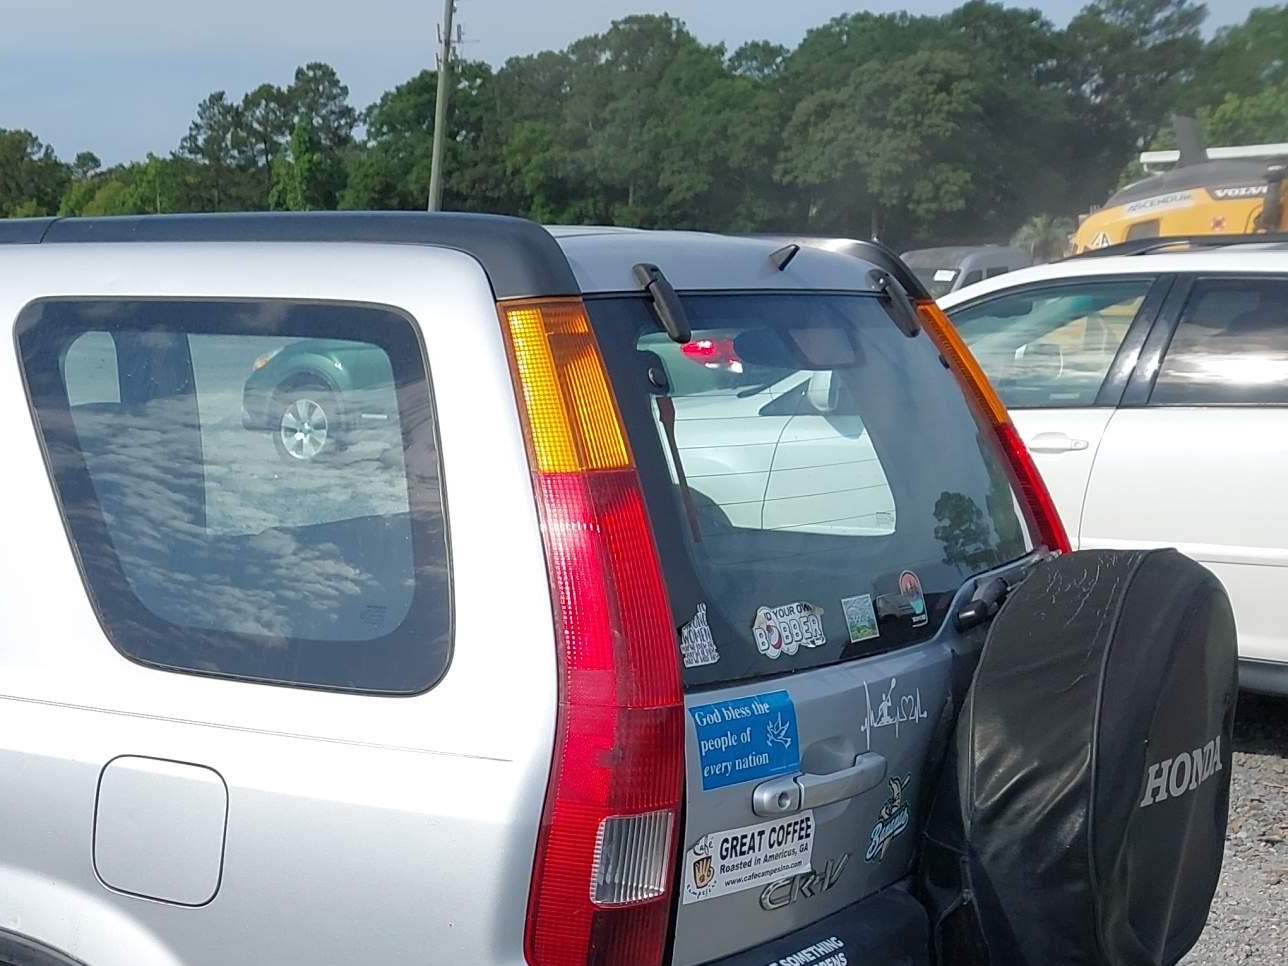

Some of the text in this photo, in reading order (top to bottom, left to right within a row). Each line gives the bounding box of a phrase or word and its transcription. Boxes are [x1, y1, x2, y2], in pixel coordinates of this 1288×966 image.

[772, 606, 795, 619] YOUR
[695, 699, 770, 727] God bless the
[700, 727, 752, 756] people of
[703, 761, 733, 777] every
[735, 752, 769, 771] nation
[1139, 735, 1223, 808] HONDA
[719, 817, 812, 861] GREAT COFFEE
[719, 842, 809, 875] Roasted in Americus, GA
[759, 853, 849, 911] CR-V
